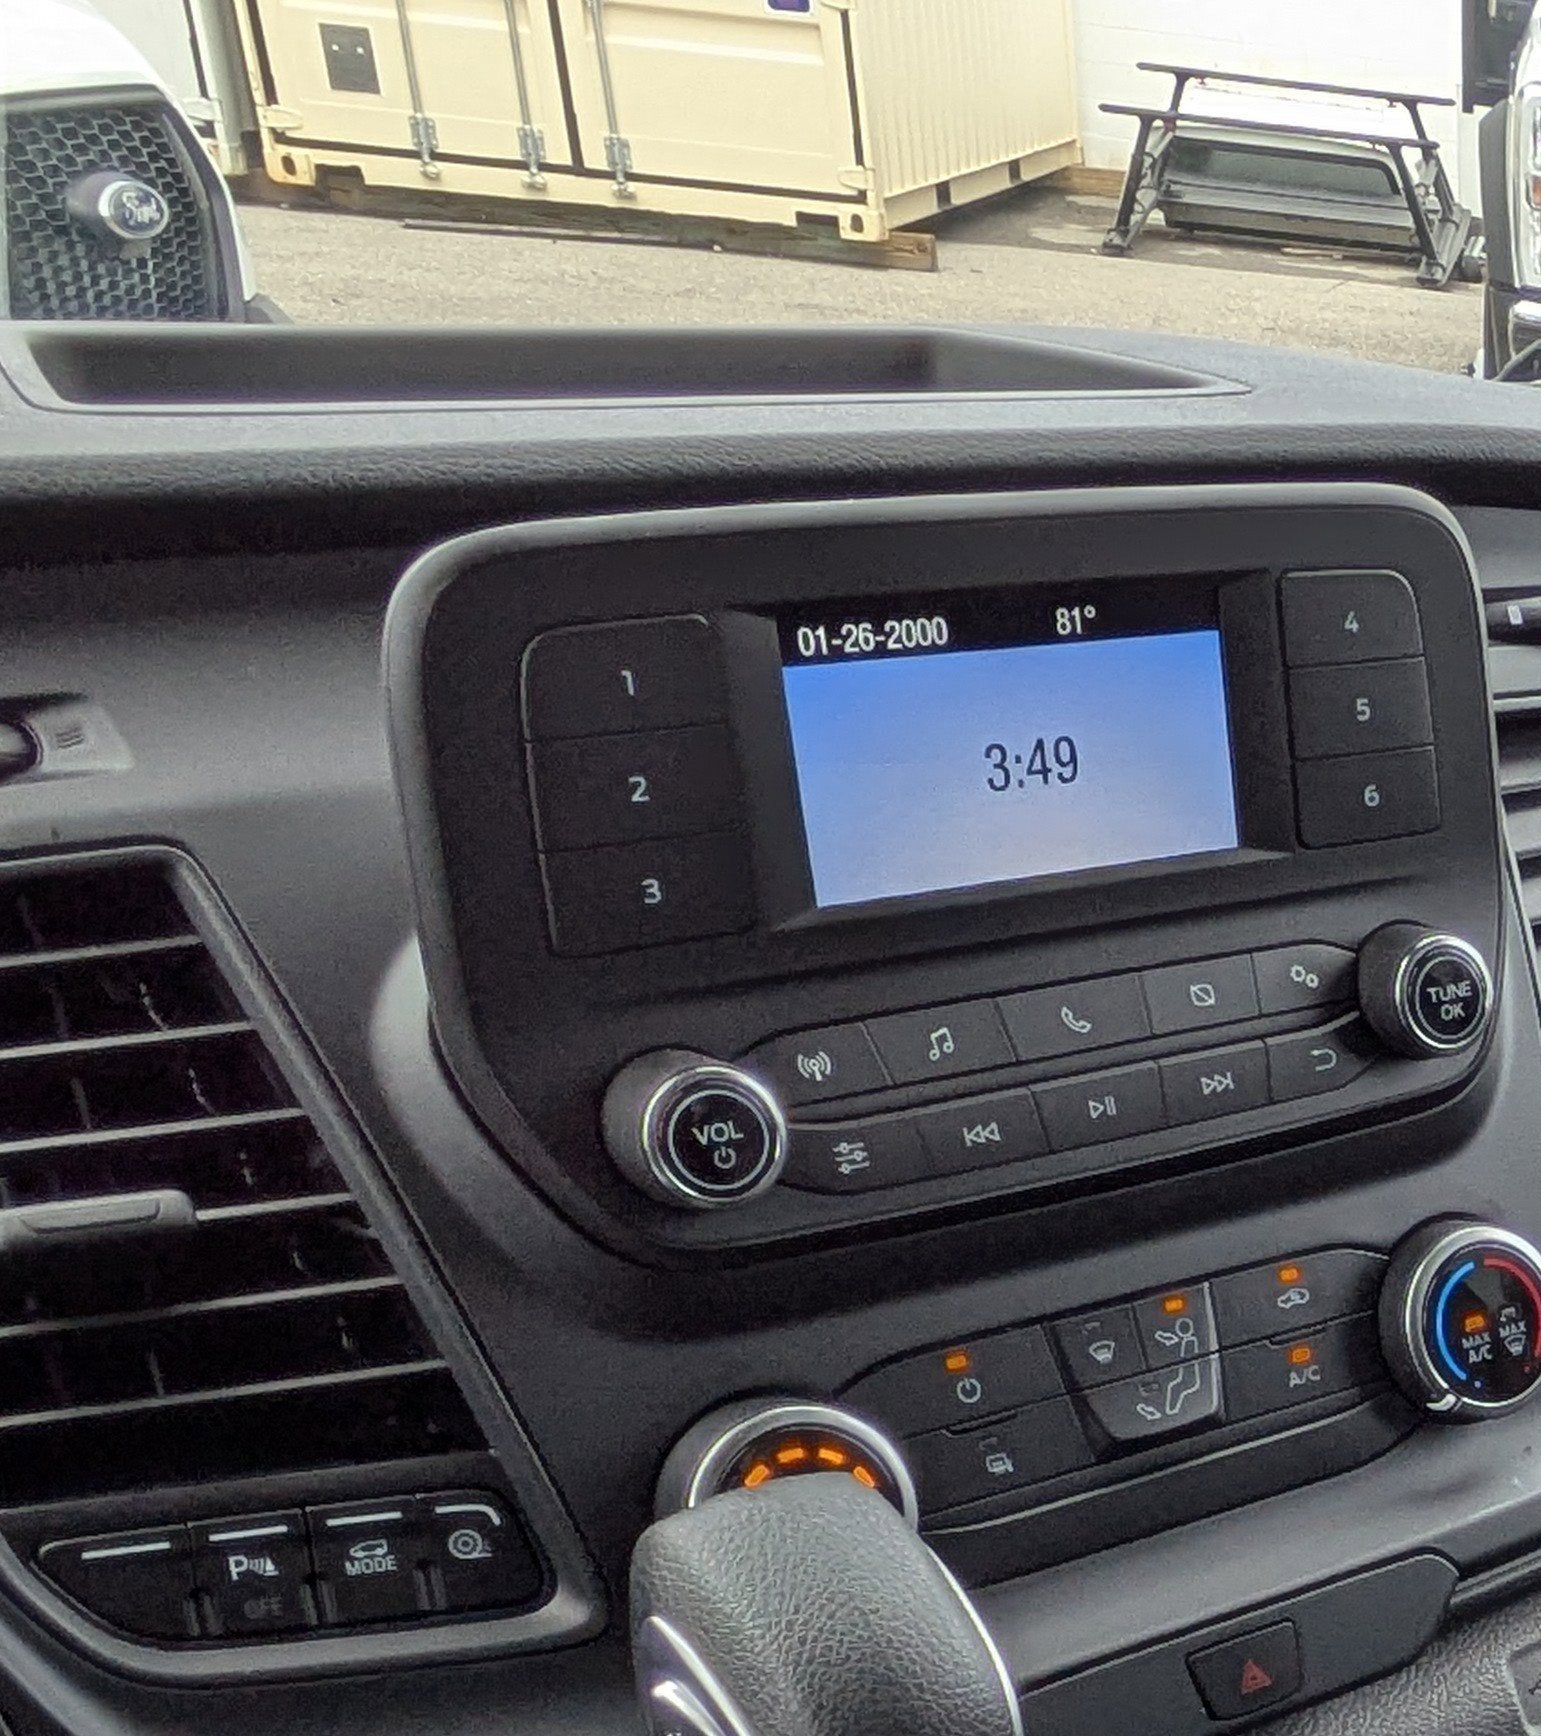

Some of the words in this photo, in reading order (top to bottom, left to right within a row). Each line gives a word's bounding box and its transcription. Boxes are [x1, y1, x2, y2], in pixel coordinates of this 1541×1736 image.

[796, 617, 949, 657] 01-26-2000
[1055, 604, 1096, 635] 81°
[1344, 612, 1361, 634] 4
[620, 669, 636, 697] 1
[1356, 698, 1371, 722] 5
[984, 736, 1078, 791] 3:49
[628, 775, 651, 803] 2
[1364, 784, 1379, 808] 6
[641, 879, 663, 905] 3
[1427, 980, 1473, 1004] TUNE
[1440, 1001, 1465, 1022] OK
[691, 1119, 745, 1146] VOL
[1461, 1331, 1492, 1350] MAX
[1498, 1321, 1527, 1338] MAX
[1468, 1344, 1493, 1364] A/C
[1288, 1363, 1322, 1389] A/C
[345, 1553, 397, 1576] MODE
